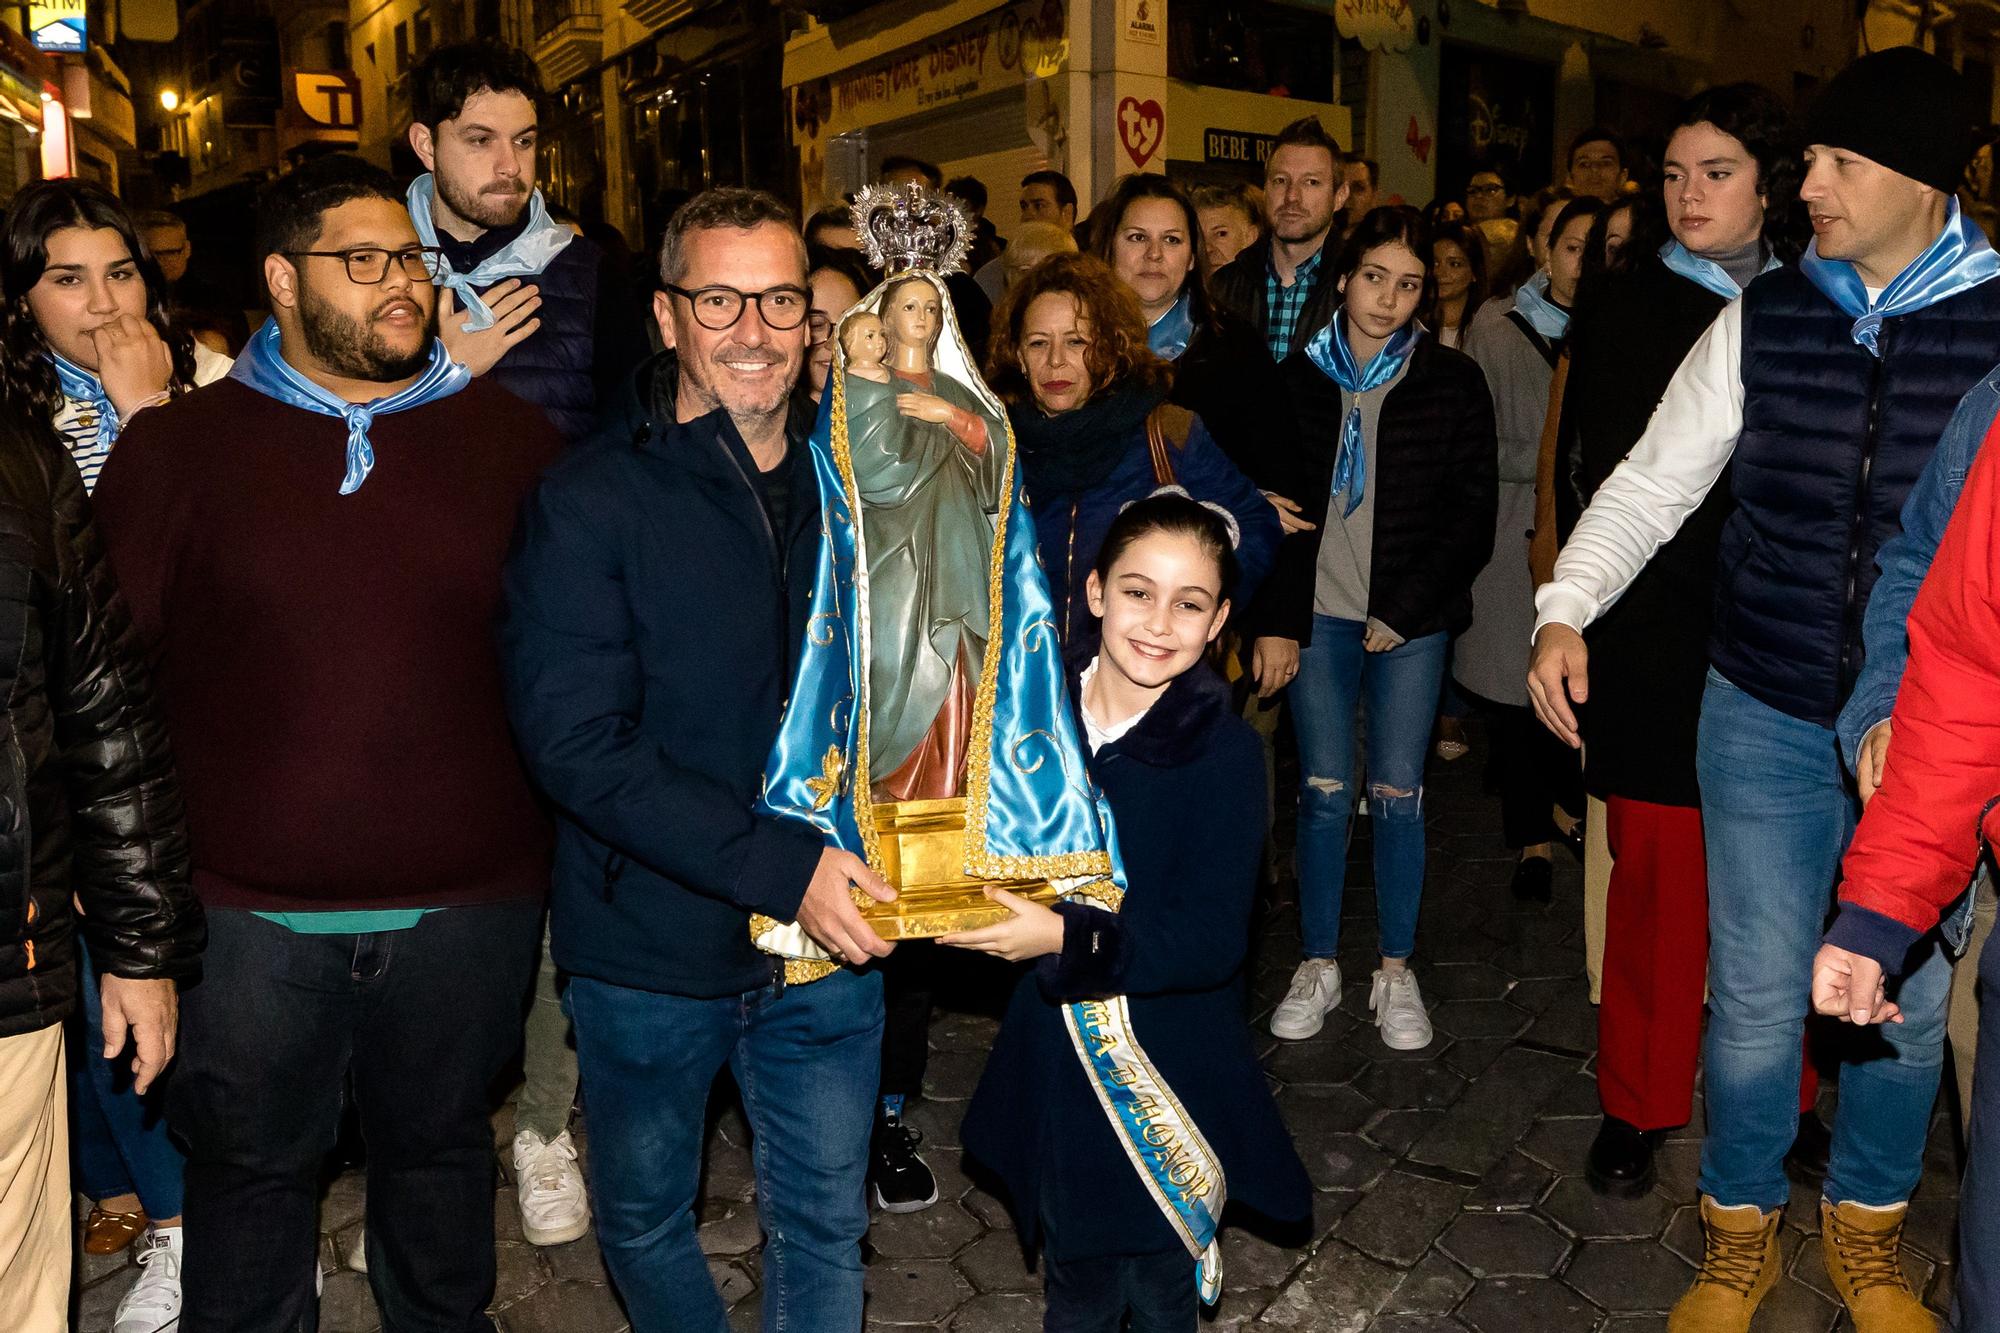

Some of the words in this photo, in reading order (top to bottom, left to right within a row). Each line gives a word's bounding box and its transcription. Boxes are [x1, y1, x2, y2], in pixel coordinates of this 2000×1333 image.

[1130, 20, 1156, 32] ALARMA
[928, 25, 989, 79] DISNEY
[1121, 101, 1158, 156] ty
[1208, 133, 1250, 161] BEBE
[1256, 139, 1275, 163] RE
